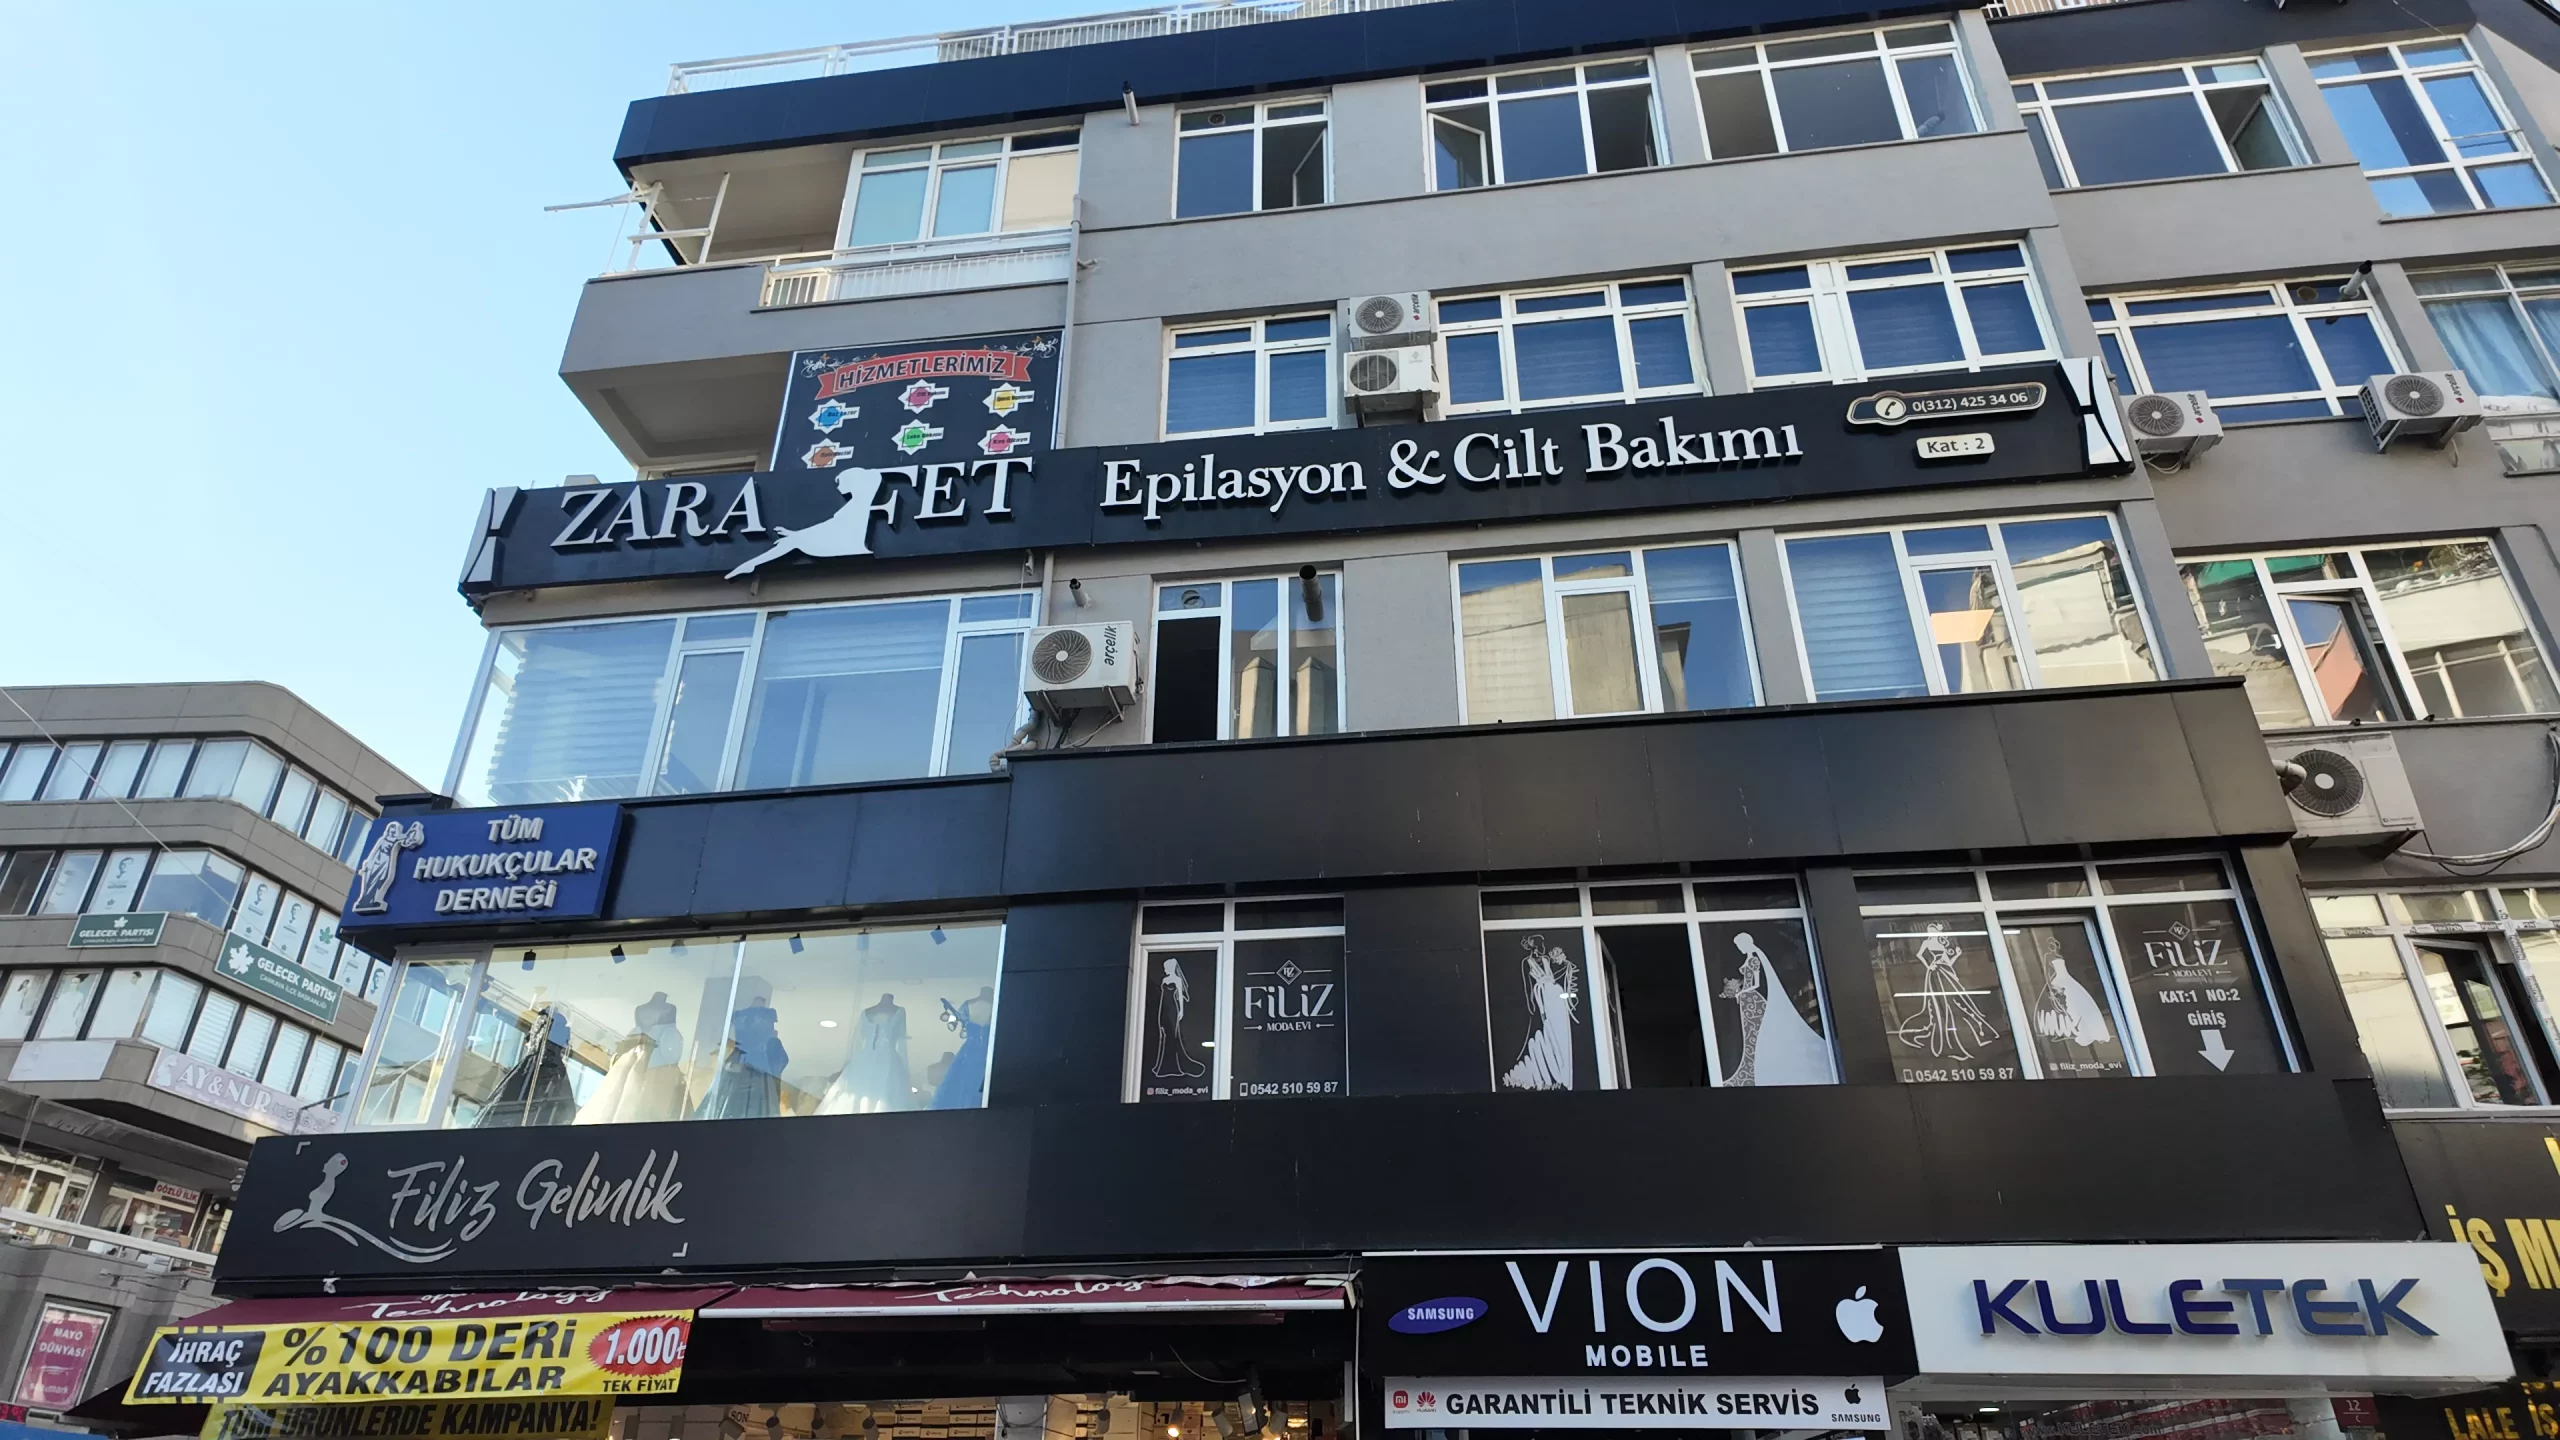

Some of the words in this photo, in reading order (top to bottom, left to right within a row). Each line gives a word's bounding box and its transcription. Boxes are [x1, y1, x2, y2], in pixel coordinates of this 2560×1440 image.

[840, 353, 1006, 387] HİZMETLERİMİZ
[1912, 398, 1957, 413] 0(312)
[1960, 396, 1986, 408] 425
[1989, 394, 2007, 406] 34
[2010, 391, 2028, 404] 06
[1927, 439, 1958, 454] Kat
[1975, 438, 1985, 450] 2
[1100, 454, 1367, 521] Epilasyon
[1454, 428, 1563, 483] Cilt
[1582, 416, 1804, 472] Bakımı
[551, 477, 766, 547] ZARA
[869, 457, 1033, 527] FET
[1104, 626, 1117, 666] arçelik
[487, 814, 543, 842] TÜM
[413, 847, 598, 881] HUKUKÇULAR
[435, 879, 557, 913] DERNEĞİ
[79, 930, 118, 938] GELECEK
[257, 957, 300, 986] GELECEK
[302, 977, 337, 1003] PARTİSİ
[2159, 990, 2198, 1003] KAT:1
[2206, 988, 2241, 1002] NO:2
[1267, 1022, 1294, 1032] MODA
[2188, 1010, 2226, 1028] GİRİŞ
[1916, 1070, 1948, 1082] 0542
[1951, 1069, 1975, 1081] 510
[1980, 1068, 1996, 1080] 59
[1999, 1067, 2014, 1080] 87
[2060, 1061, 2122, 1072] filiz_moda_evi
[1155, 1086, 1208, 1096] filiz_moda_evi
[1250, 1083, 1278, 1095] 0542
[1282, 1083, 1303, 1095] 510
[1307, 1082, 1321, 1094] 59
[1324, 1081, 1338, 1093] 87
[387, 1156, 500, 1242] Filiz
[516, 1149, 686, 1230] Gelinlik
[1506, 1258, 1783, 1334] VION
[1971, 1278, 2440, 1337] KULETEK
[1408, 1308, 1474, 1320] SAMSUNG
[53, 1328, 83, 1341] MAYO
[40, 1342, 86, 1358] DÜNYASI
[168, 1337, 244, 1368] İHRAÇ
[1586, 1345, 1708, 1367] MOBILE
[143, 1372, 244, 1395] FAZLASI
[263, 1366, 566, 1397] AYAKKABILAR
[603, 1379, 631, 1392] TEK
[637, 1377, 676, 1392] FİYAT
[1446, 1387, 1591, 1416] GARANTİLİ
[1600, 1387, 1708, 1416] TEKNİK
[1716, 1387, 1819, 1416] SERVİS
[279, 1402, 438, 1438] ÜRÜNLERDE
[440, 1400, 601, 1436] KAMPANYA!
[1831, 1413, 1881, 1423] SAMSUNG
[2444, 1407, 2520, 1440] LALE
